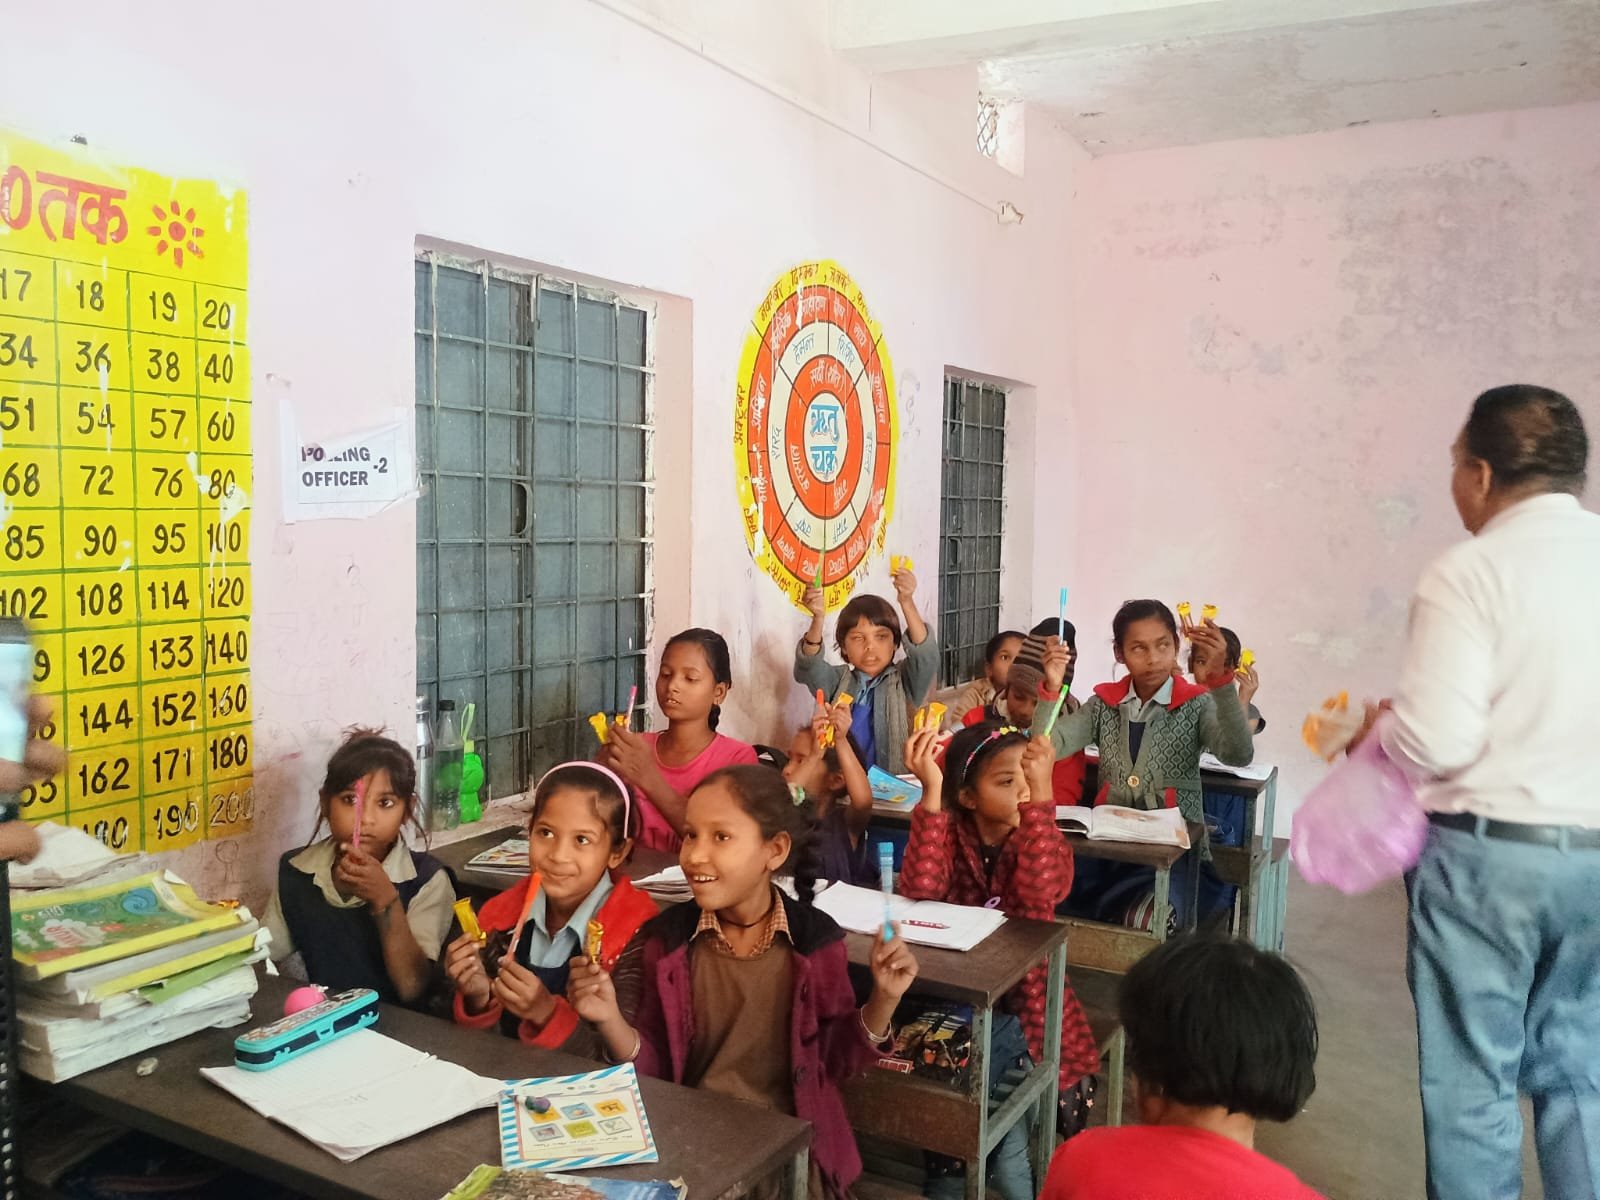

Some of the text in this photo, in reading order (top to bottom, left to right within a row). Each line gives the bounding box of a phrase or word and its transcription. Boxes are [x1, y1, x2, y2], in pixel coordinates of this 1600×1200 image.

[0, 268, 231, 330] 17 18 19 20
[0, 332, 234, 385] 34 36 38 40
[0, 397, 236, 442] 51 54 57 60
[301, 446, 371, 462] POING
[790, 442, 810, 495] बरसात
[2, 462, 236, 500] 68 72 76 80
[301, 470, 369, 487] OFFICER
[5, 521, 242, 562] 85 90 95 100
[0, 576, 245, 619] 102 108 114 120
[827, 584, 842, 609] जून
[78, 643, 126, 677] 126
[150, 635, 195, 671] 133
[207, 629, 248, 666] 140
[79, 699, 134, 737] 144
[152, 690, 198, 727] 152
[208, 683, 248, 719] 160
[79, 757, 131, 798] 162
[152, 748, 192, 783] 171
[209, 734, 249, 770] 180
[153, 799, 200, 841] 190
[209, 788, 256, 828] 200
